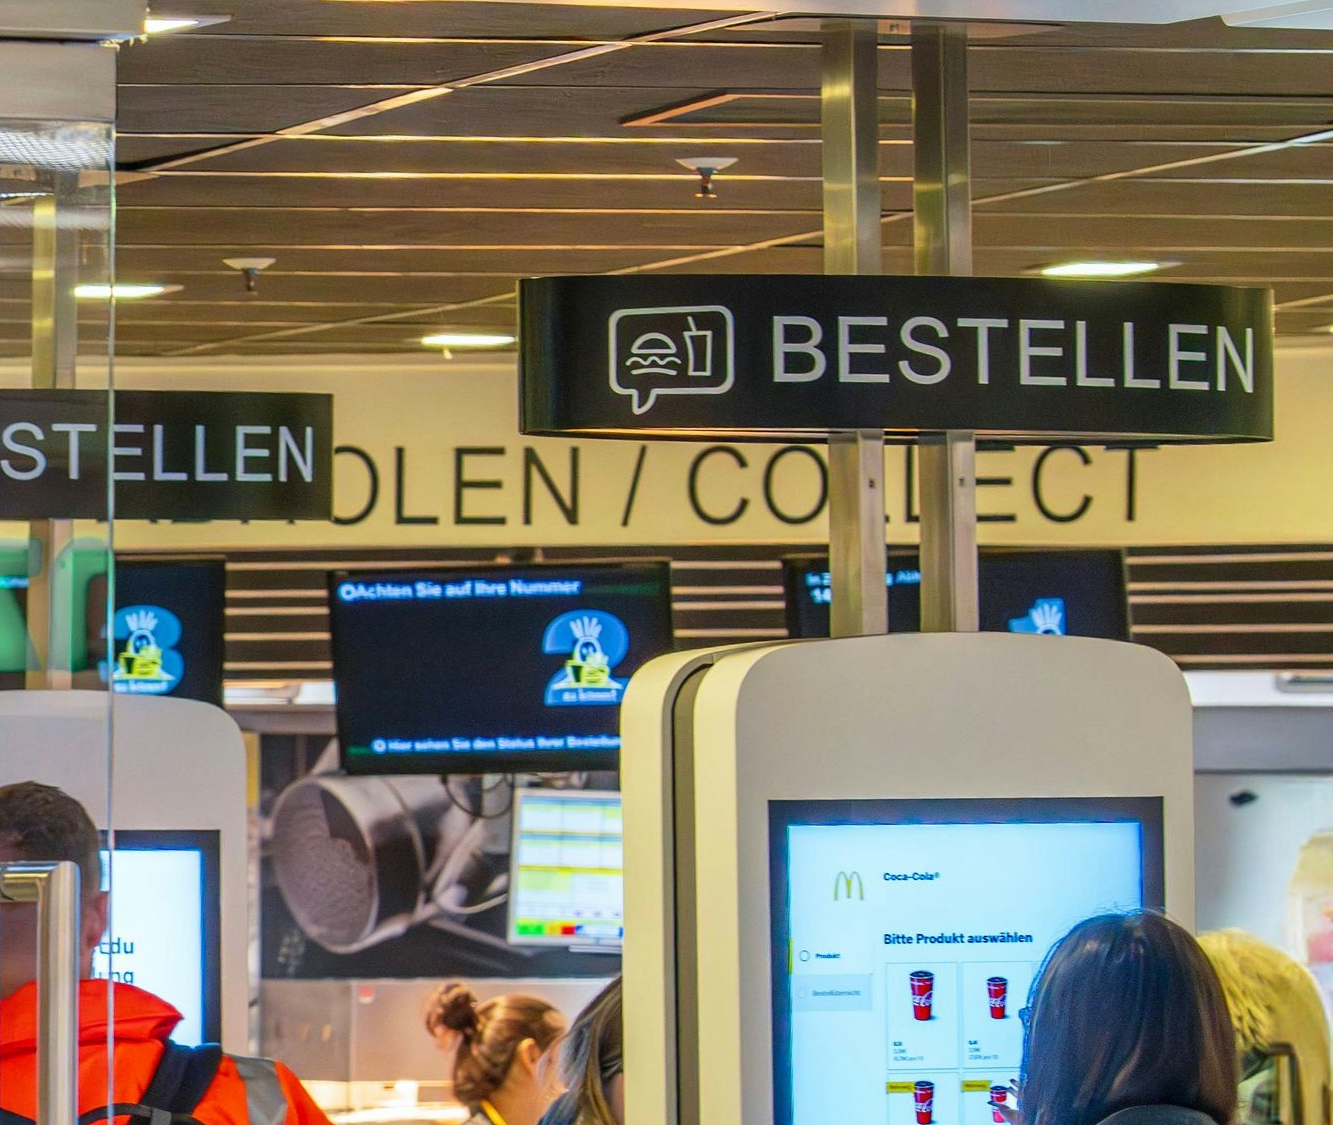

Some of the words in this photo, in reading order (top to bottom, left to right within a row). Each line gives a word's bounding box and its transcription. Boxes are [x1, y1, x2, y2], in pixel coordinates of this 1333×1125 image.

[773, 315, 1254, 394] BESTELLEN
[356, 582, 413, 599] Achten
[415, 581, 442, 597] Sie
[444, 581, 473, 597] auf
[475, 581, 508, 597] Ihre
[510, 579, 580, 596] Nummer
[883, 933, 914, 944] Bitte
[916, 932, 965, 944] Produkt
[967, 931, 1033, 944] auswählen
